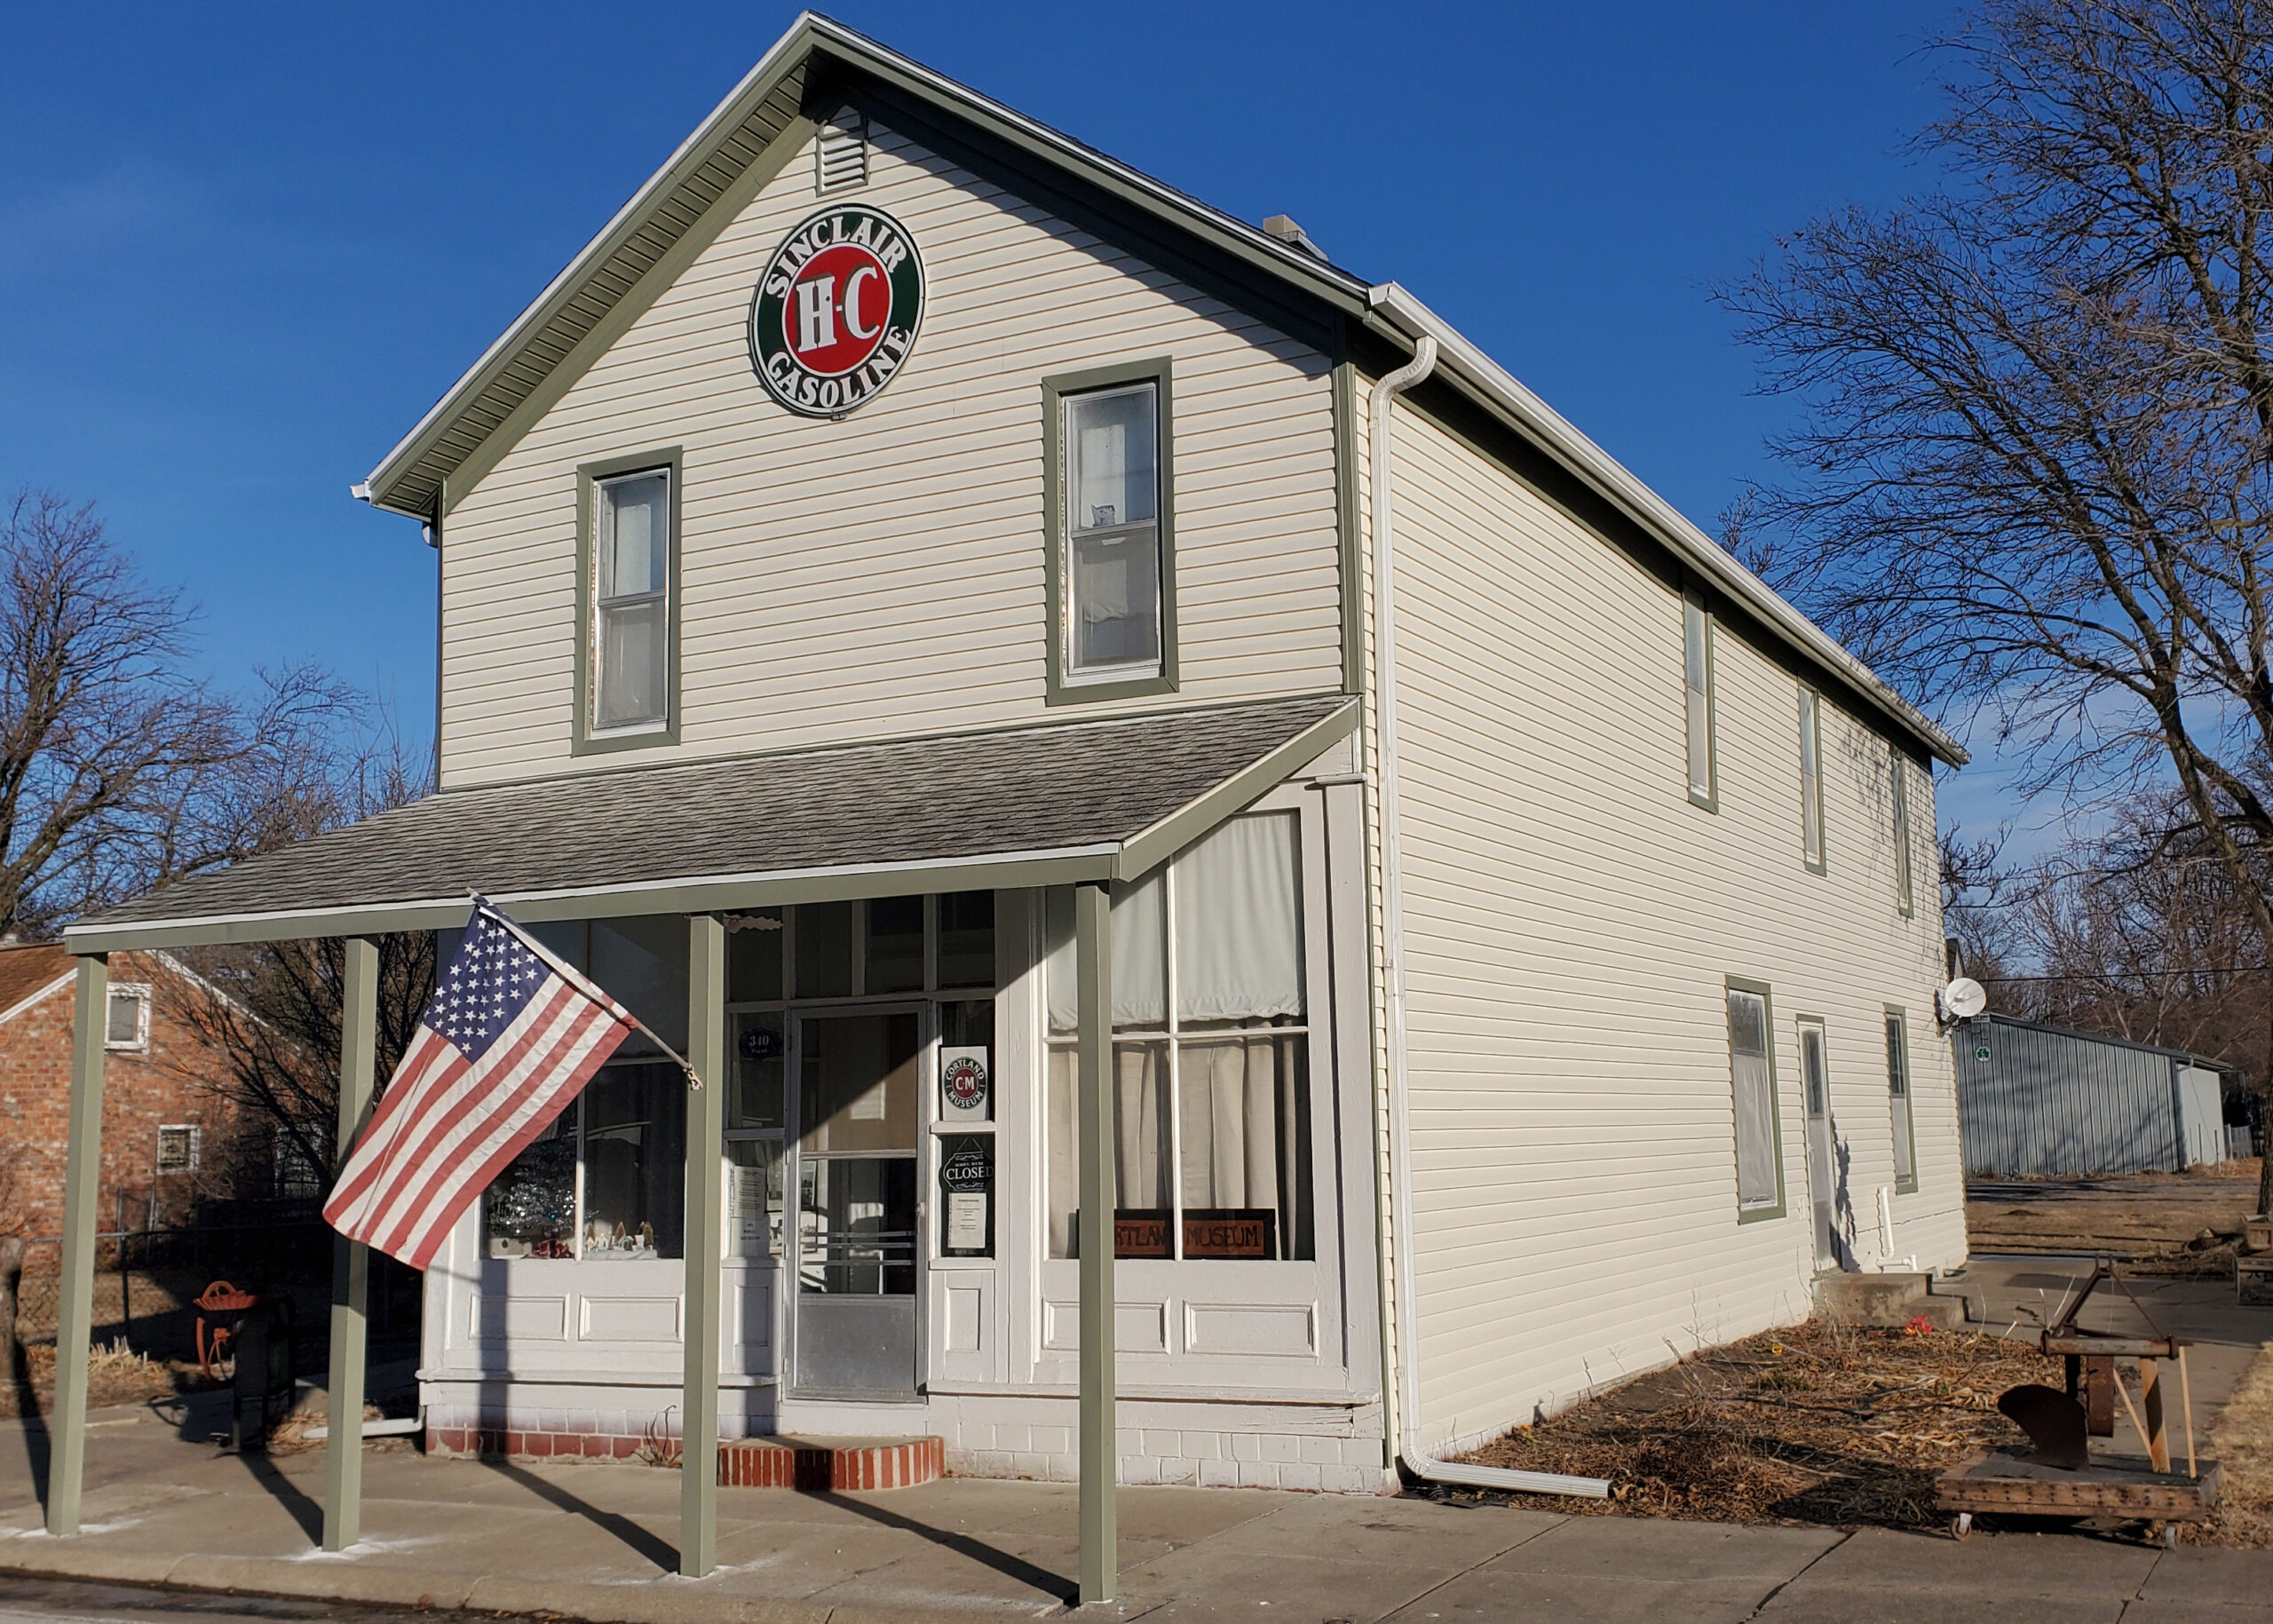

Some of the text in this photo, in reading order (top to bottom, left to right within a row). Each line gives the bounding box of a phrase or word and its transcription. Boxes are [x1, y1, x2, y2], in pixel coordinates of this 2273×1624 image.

[765, 216, 907, 298] SINCLAIR
[768, 325, 911, 408] GASOLINE
[946, 1059, 985, 1081] CORTLAND
[947, 1090, 984, 1108] MUSEUM
[946, 1166, 994, 1180] CLOSED
[1185, 1225, 1260, 1247] MUSEUM
